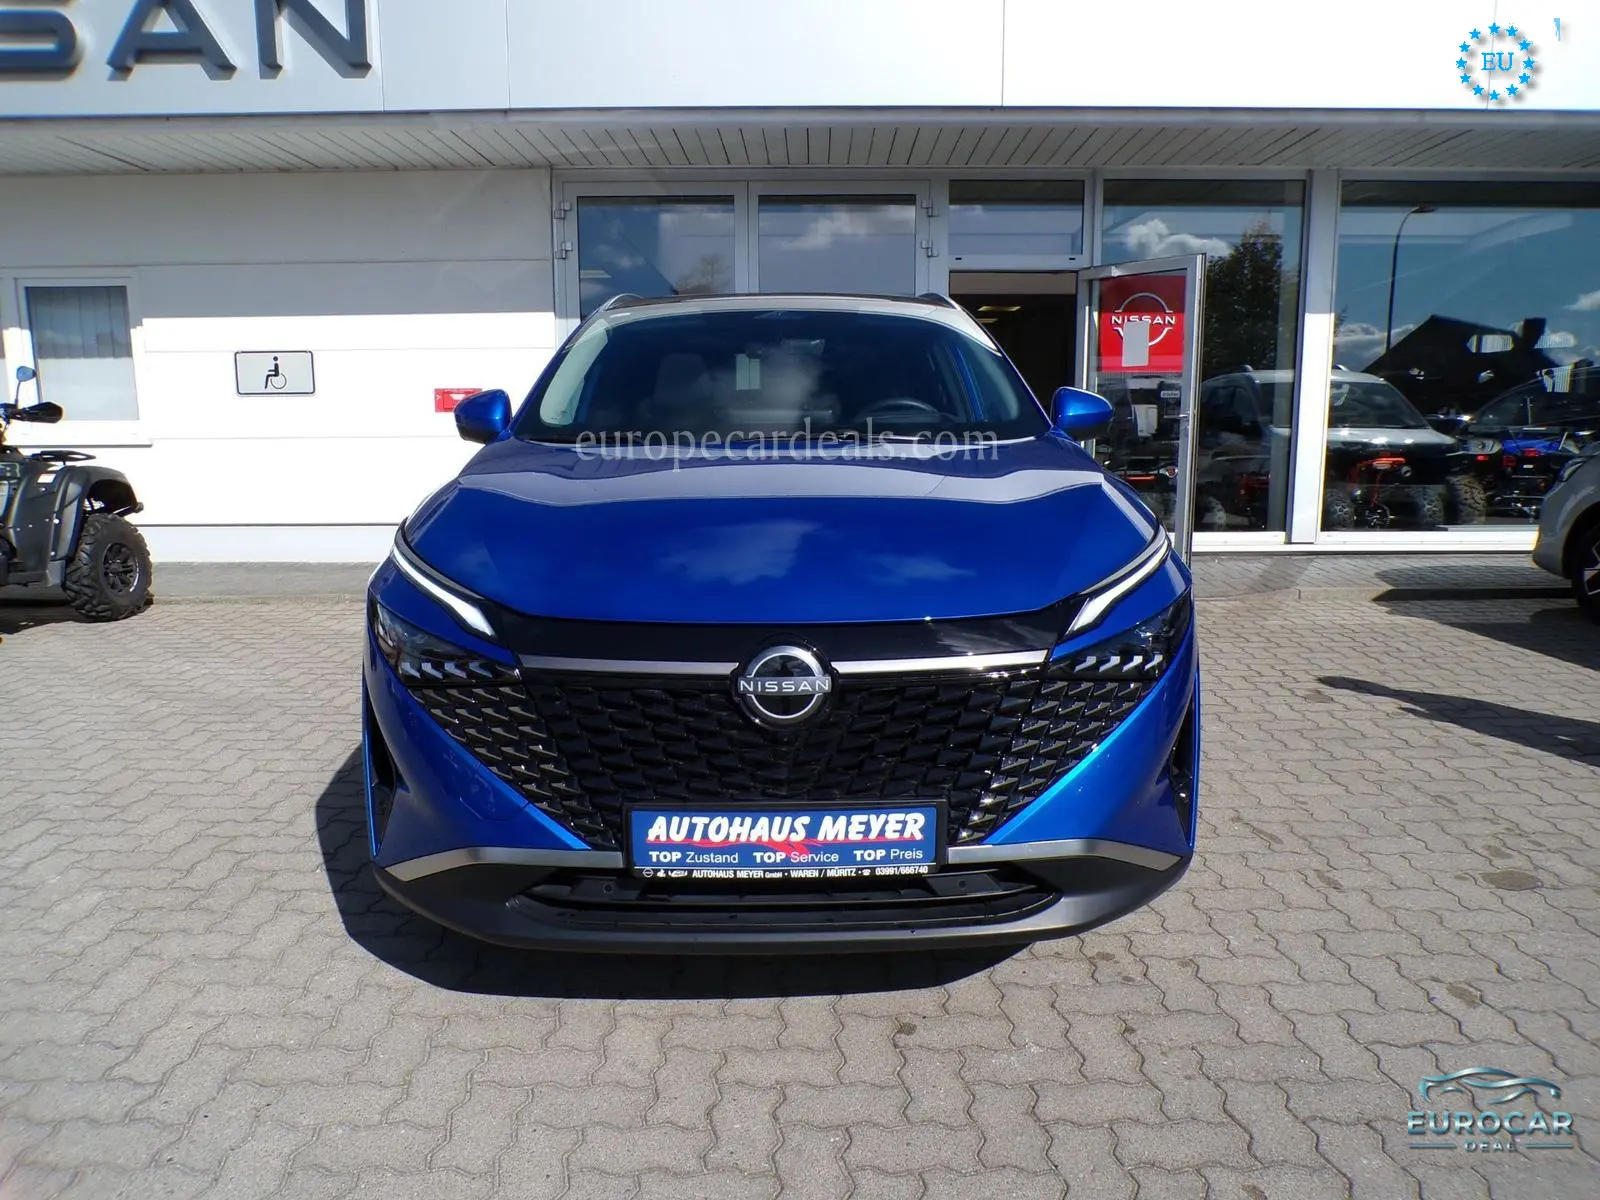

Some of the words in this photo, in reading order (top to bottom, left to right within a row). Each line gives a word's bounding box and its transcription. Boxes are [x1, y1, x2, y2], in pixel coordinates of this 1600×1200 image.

[1111, 315, 1176, 325] NISSAN
[740, 679, 830, 692] NISSAN
[647, 815, 811, 842] AUTOHAUS
[817, 813, 926, 841] MEYER
[649, 851, 682, 863] TOP
[686, 852, 739, 863] Zustand
[753, 852, 786, 863] TOP
[790, 851, 839, 863] Service
[853, 849, 886, 861] TOP
[890, 848, 924, 860] Preis
[692, 869, 735, 878] AUTOHAUS
[736, 870, 764, 878] MEYER
[790, 868, 819, 878] WAREN
[826, 867, 857, 877] MÜRITZ
